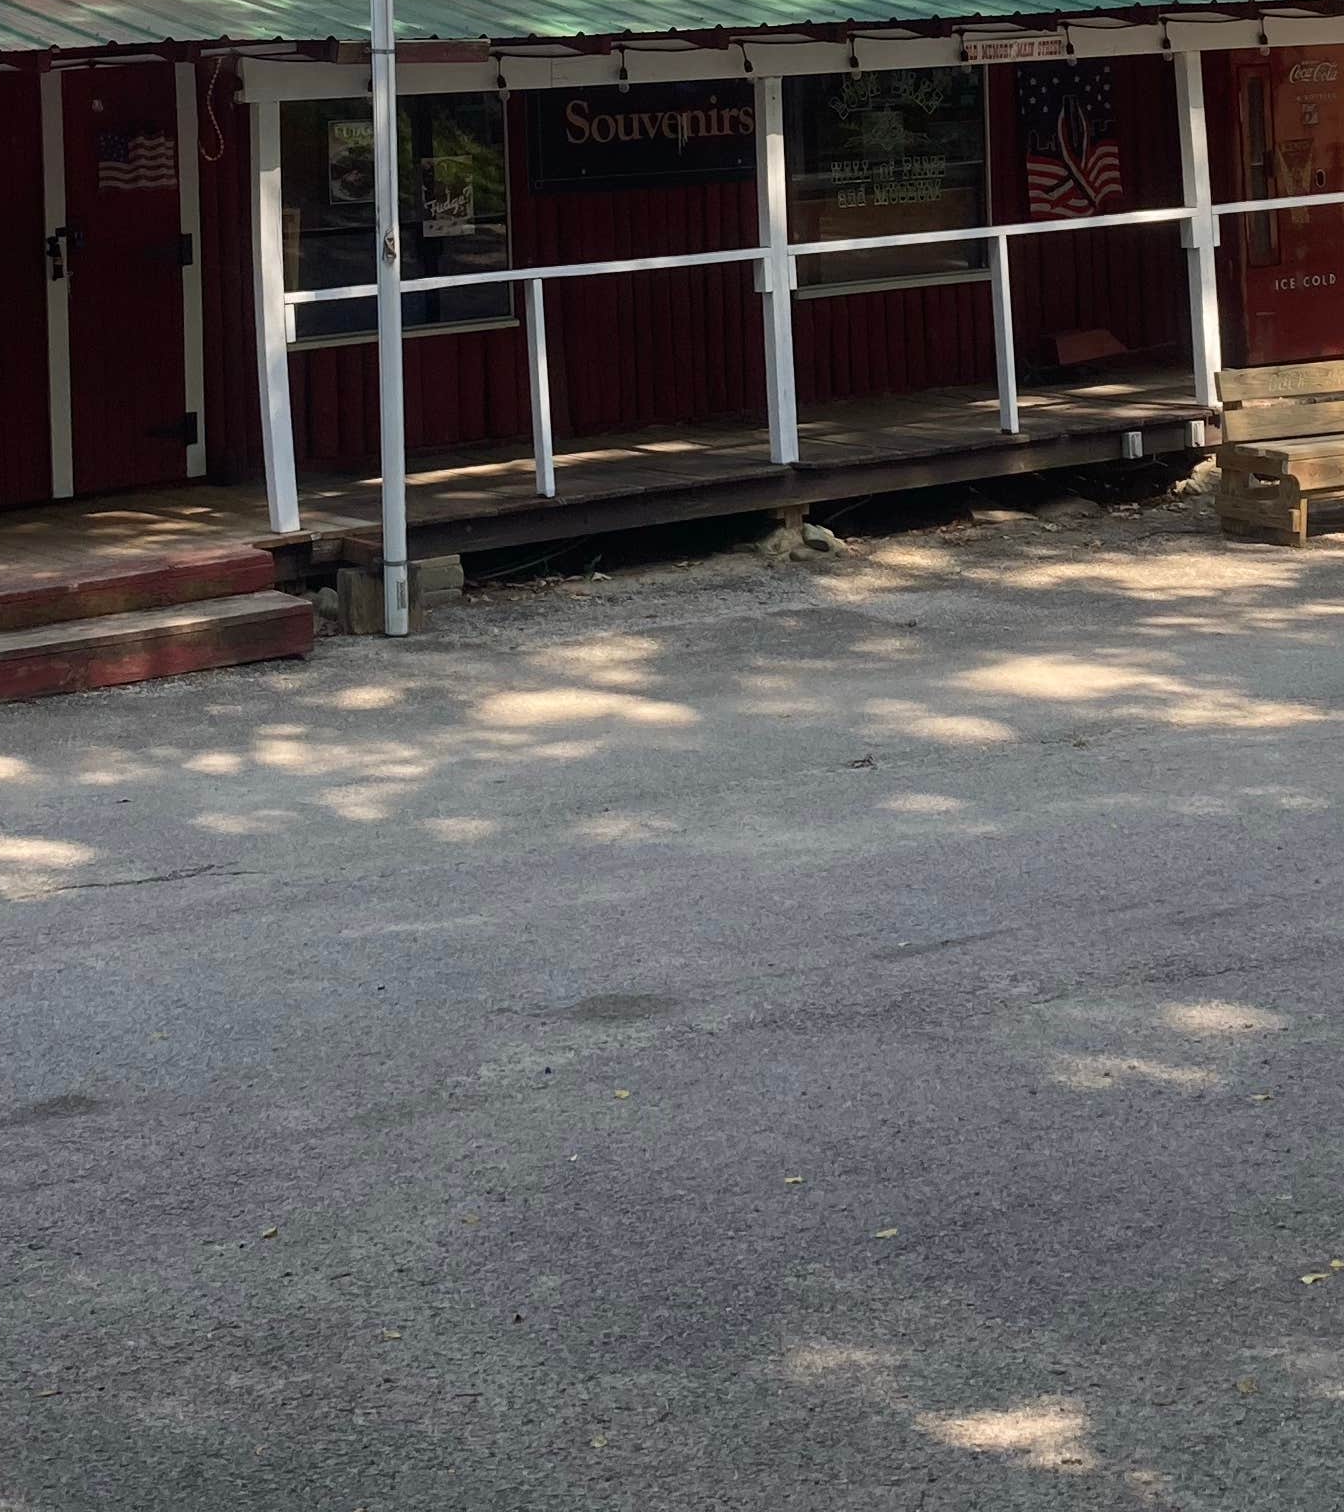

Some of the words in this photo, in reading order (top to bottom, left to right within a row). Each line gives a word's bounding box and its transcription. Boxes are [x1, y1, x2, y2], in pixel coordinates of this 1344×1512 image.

[1289, 61, 1337, 85] Coca-Cola
[565, 95, 755, 144] Souvenirs
[1275, 277, 1296, 291] ICE
[1303, 273, 1337, 288] COLD
